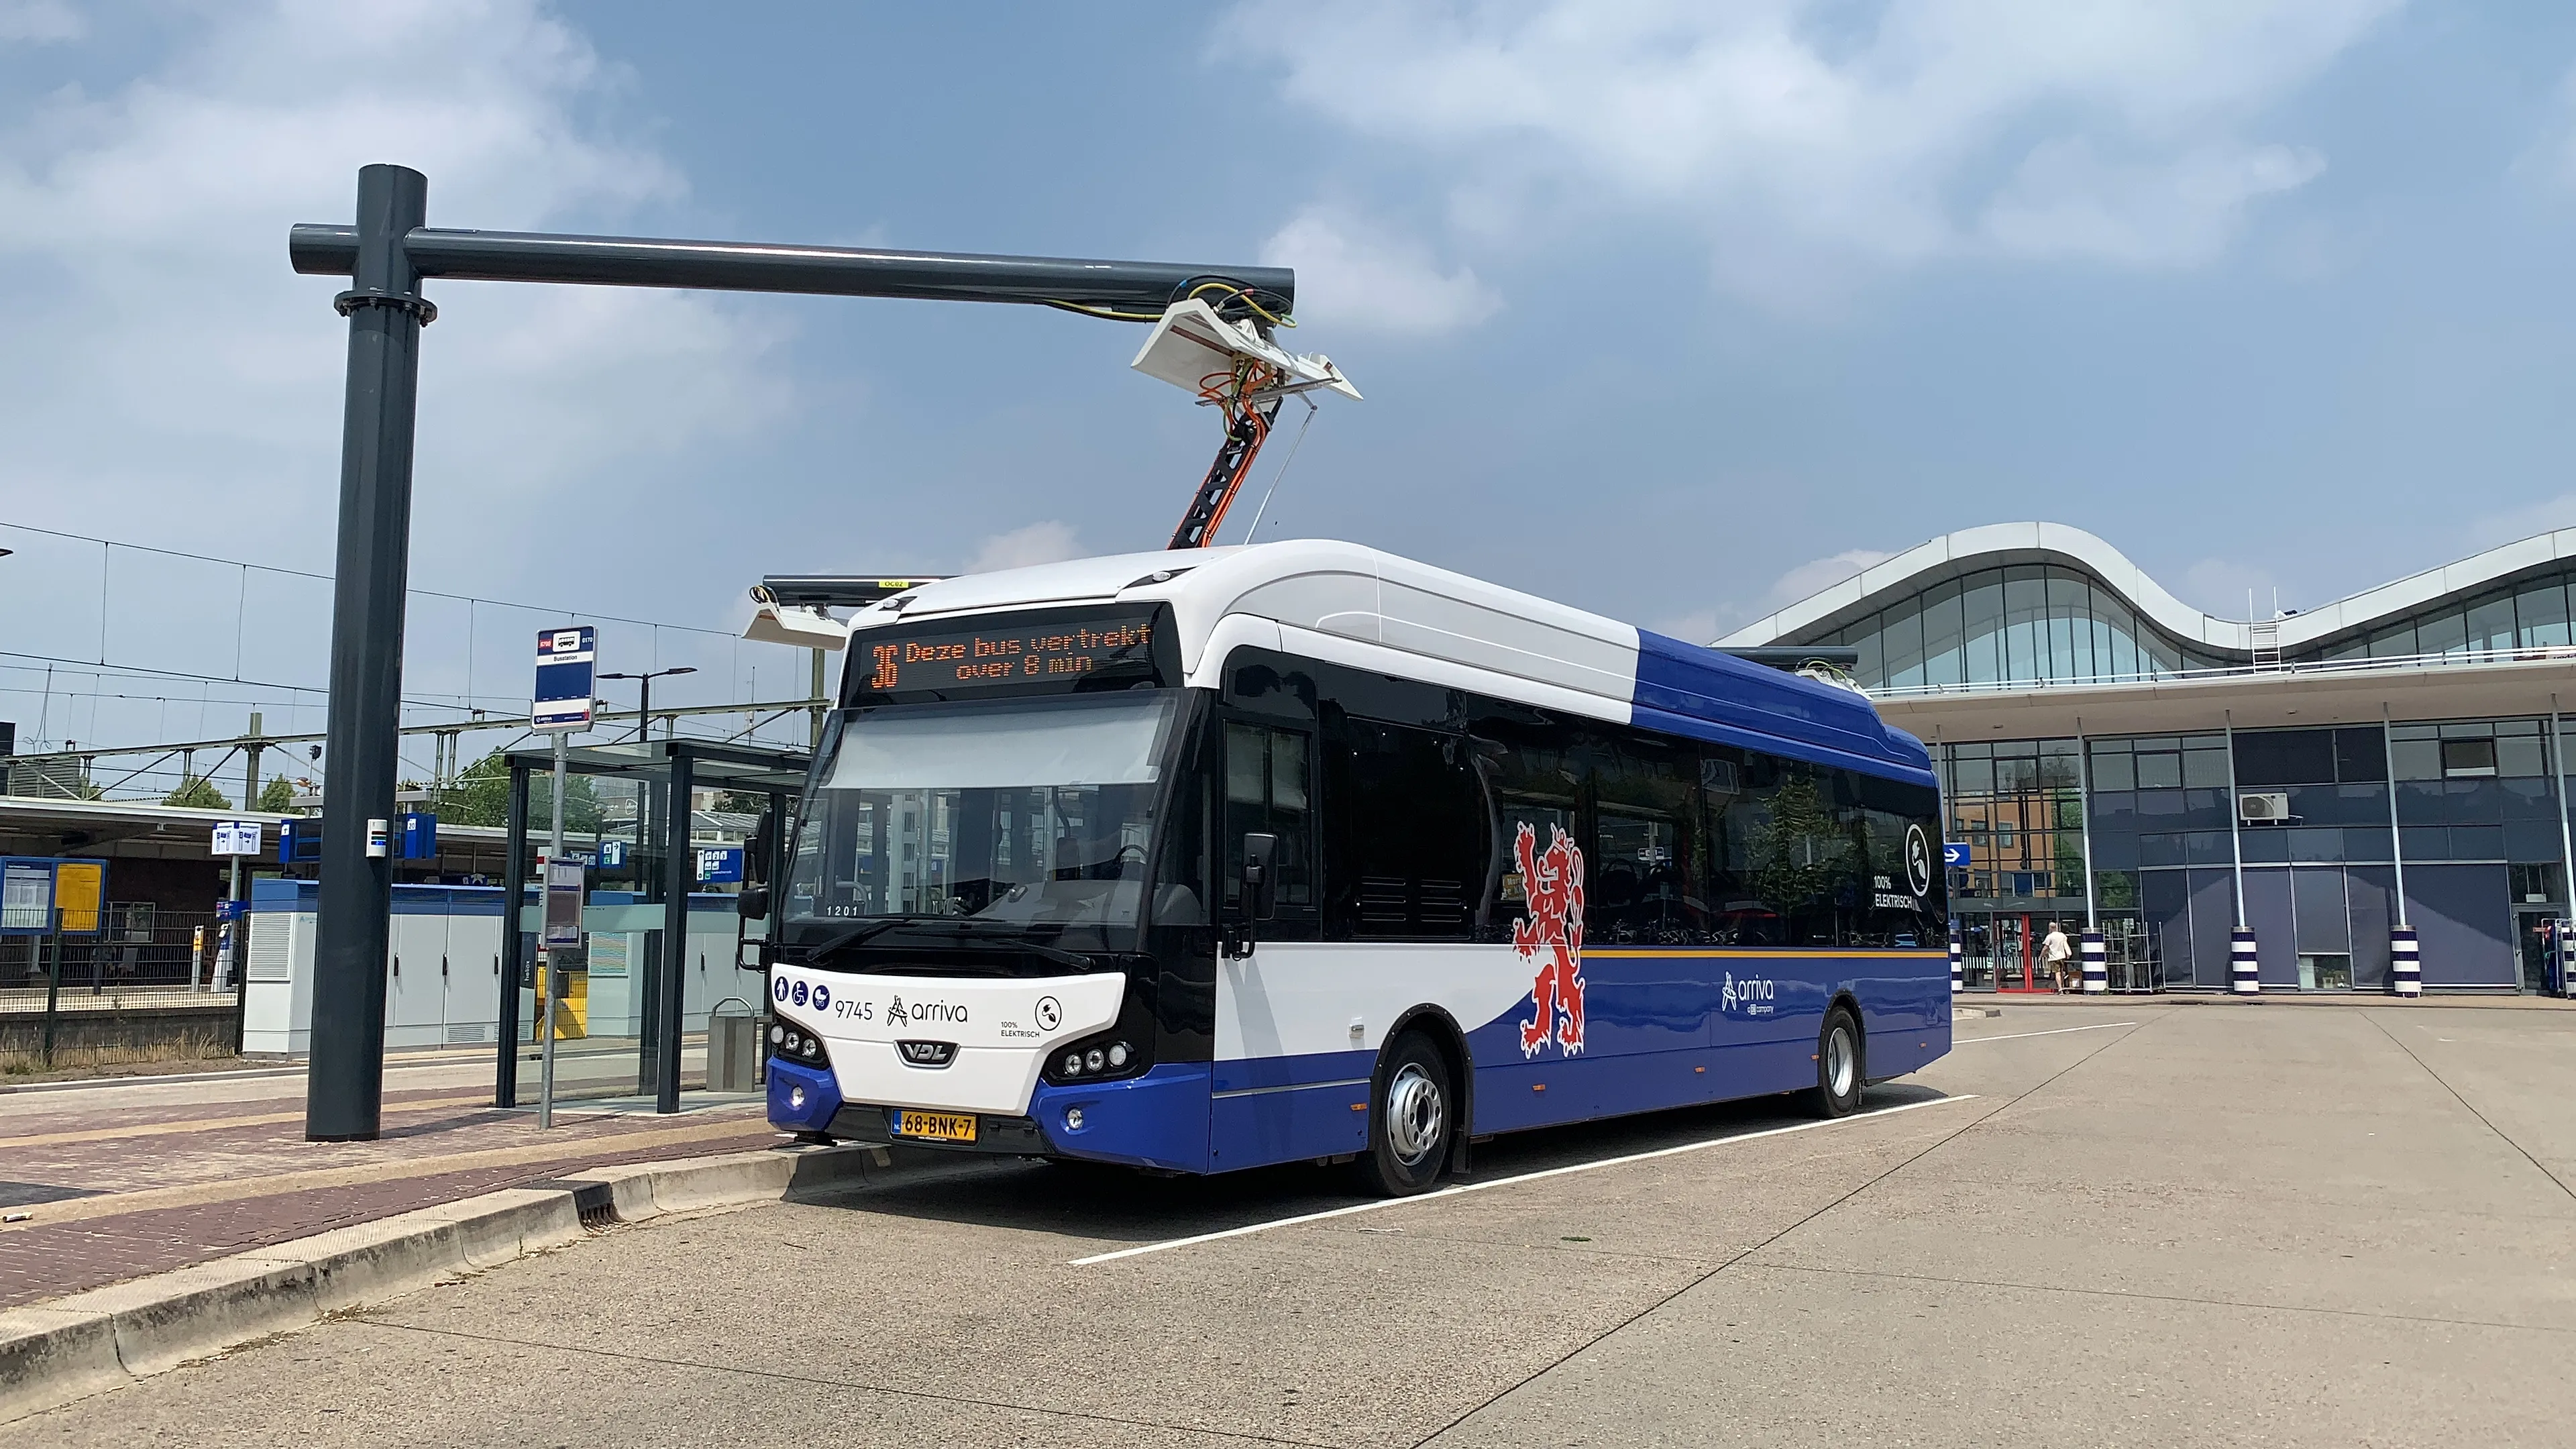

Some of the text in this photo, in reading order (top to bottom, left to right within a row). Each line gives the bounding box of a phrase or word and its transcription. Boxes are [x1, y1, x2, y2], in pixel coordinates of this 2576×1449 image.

[906, 623, 1151, 663] Deze bus vertrekt
[872, 645, 898, 688] 36
[956, 651, 1093, 680] over 8 min
[1874, 875, 1892, 890] 100%
[826, 906, 857, 916] 1201
[1874, 893, 1913, 909] ELEKTRISCH
[1738, 973, 1774, 1001] arriva
[835, 1000, 873, 1020] 9745
[912, 1000, 967, 1023] arriva
[1001, 1030, 1040, 1038] ELEKTRISCH
[904, 1044, 947, 1060] VDL
[905, 1114, 972, 1137] 68-BNK-7
